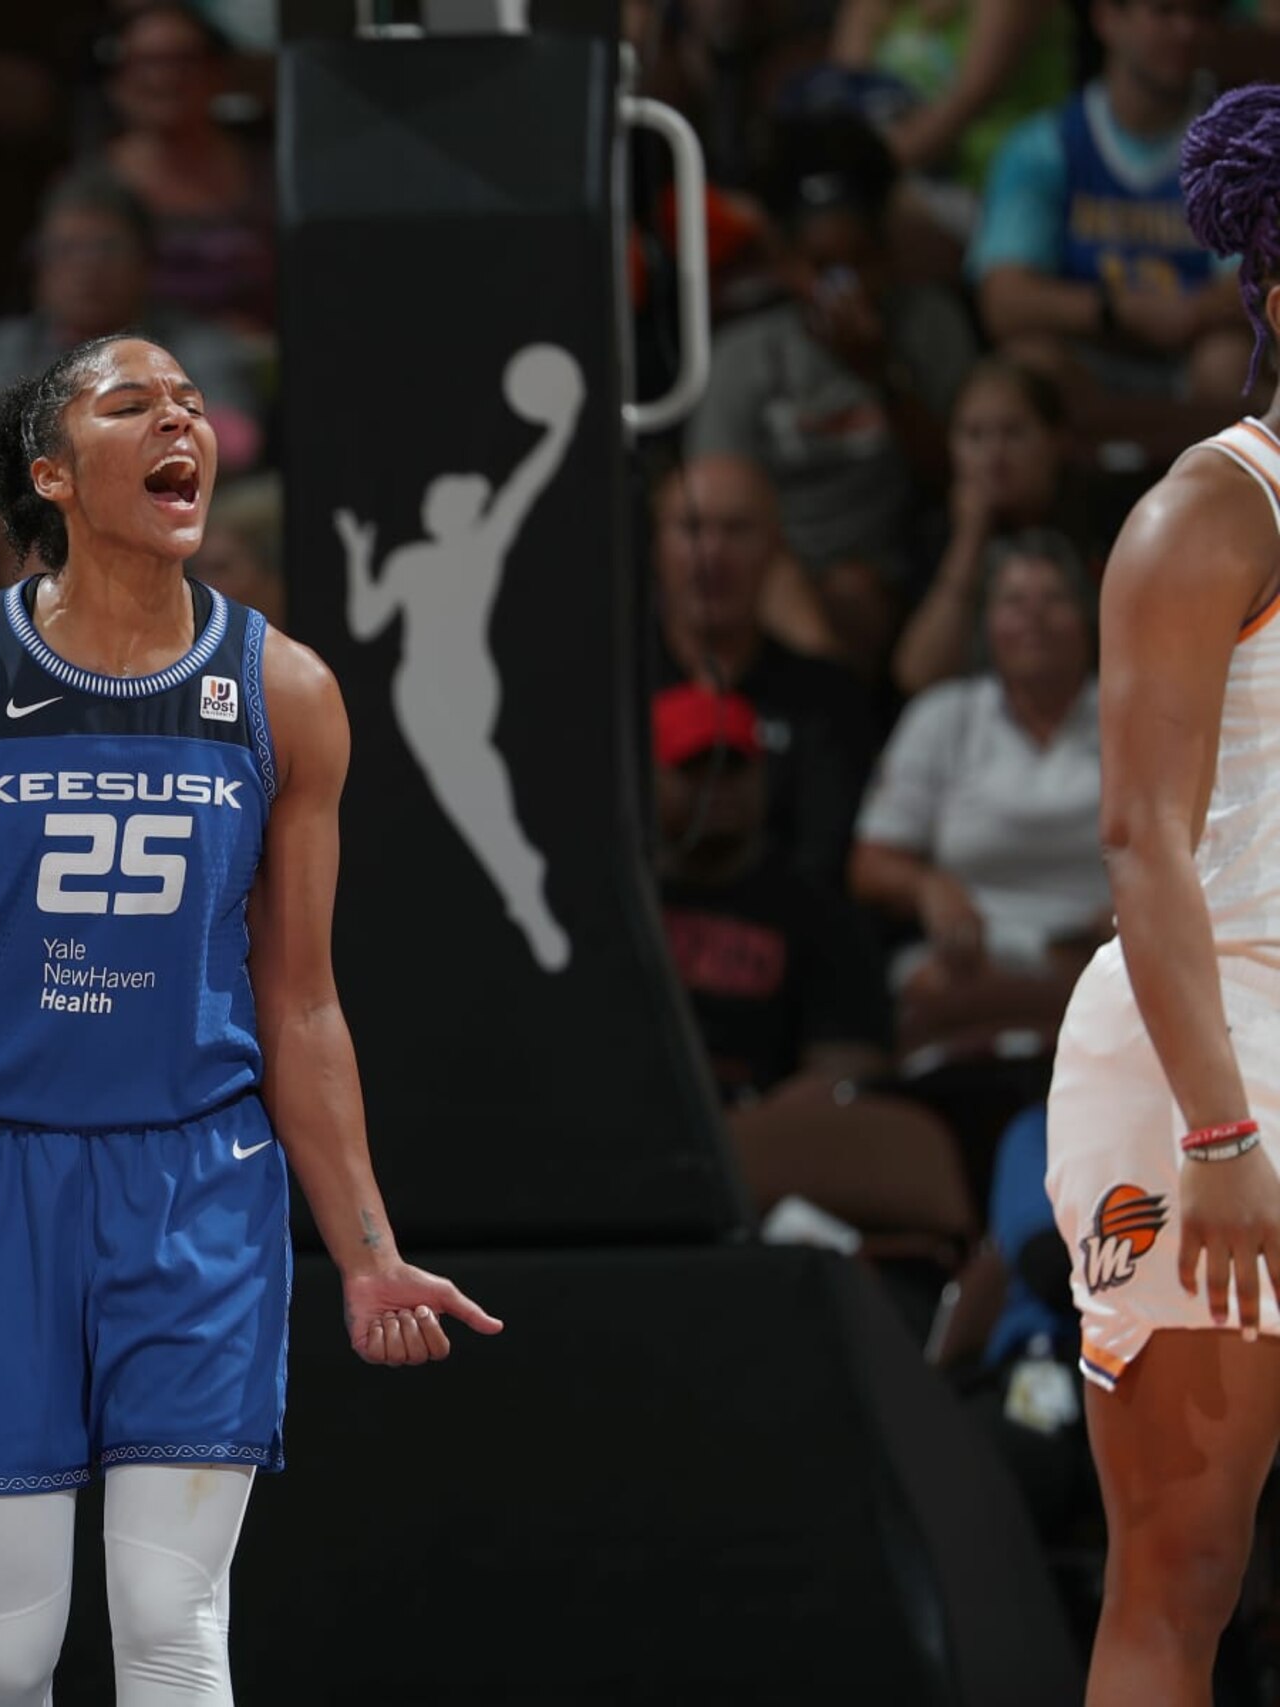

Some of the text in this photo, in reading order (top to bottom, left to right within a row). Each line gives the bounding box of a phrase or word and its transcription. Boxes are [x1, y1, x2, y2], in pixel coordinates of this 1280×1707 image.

[203, 697, 235, 713] Post
[37, 813, 193, 915] 25
[43, 938, 86, 960] Yale
[40, 988, 112, 1014] Health
